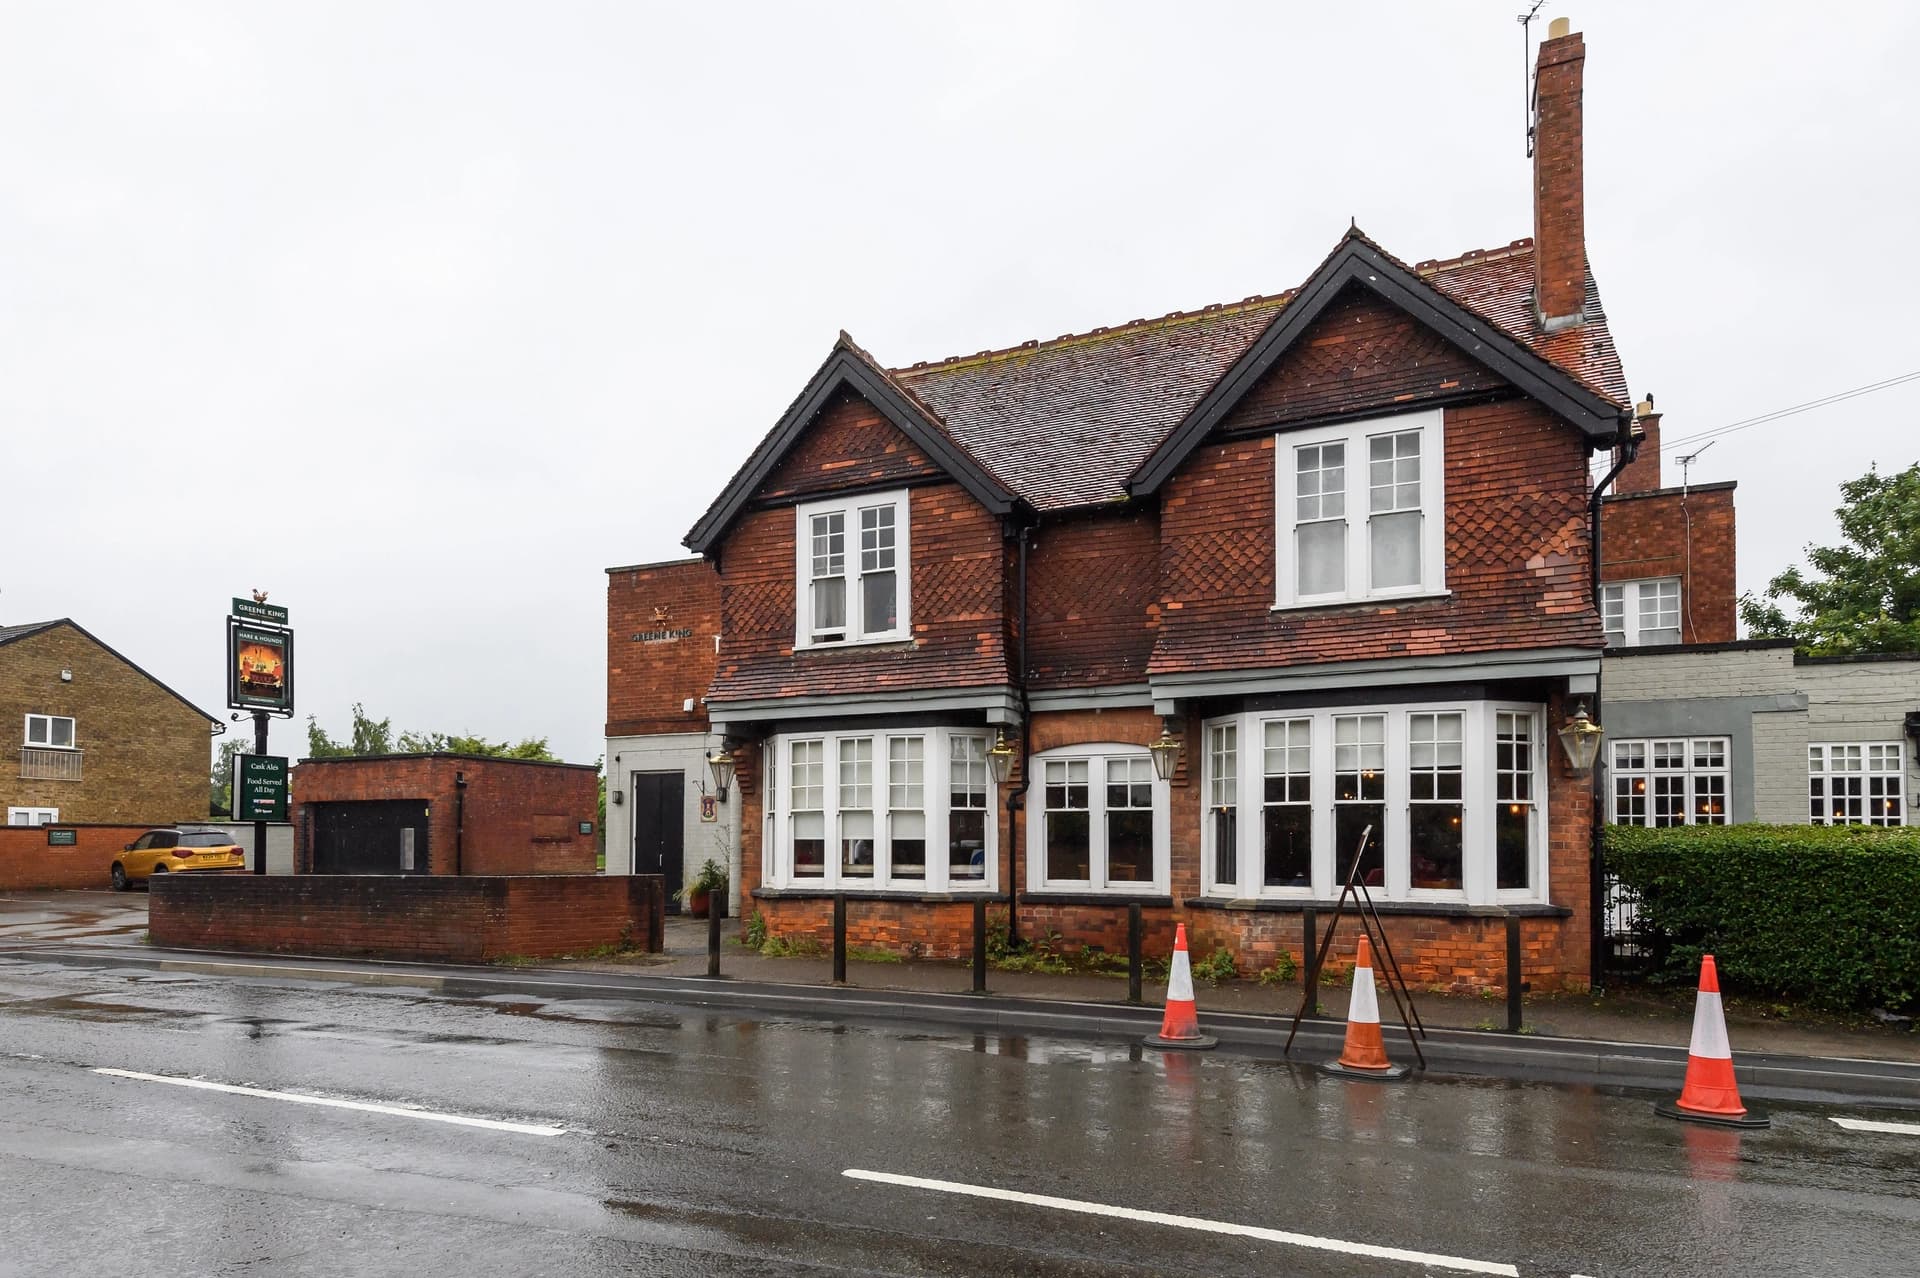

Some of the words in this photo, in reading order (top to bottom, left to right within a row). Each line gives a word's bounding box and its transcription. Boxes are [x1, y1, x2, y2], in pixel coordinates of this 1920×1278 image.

[238, 604, 265, 615] GREENE
[267, 610, 285, 619] KING
[239, 632, 253, 640] HARE
[259, 636, 283, 645] HOUNDS
[631, 632, 667, 642] GREENE
[669, 628, 692, 638] KING
[266, 763, 279, 771] Ales
[263, 787, 275, 795] Day
